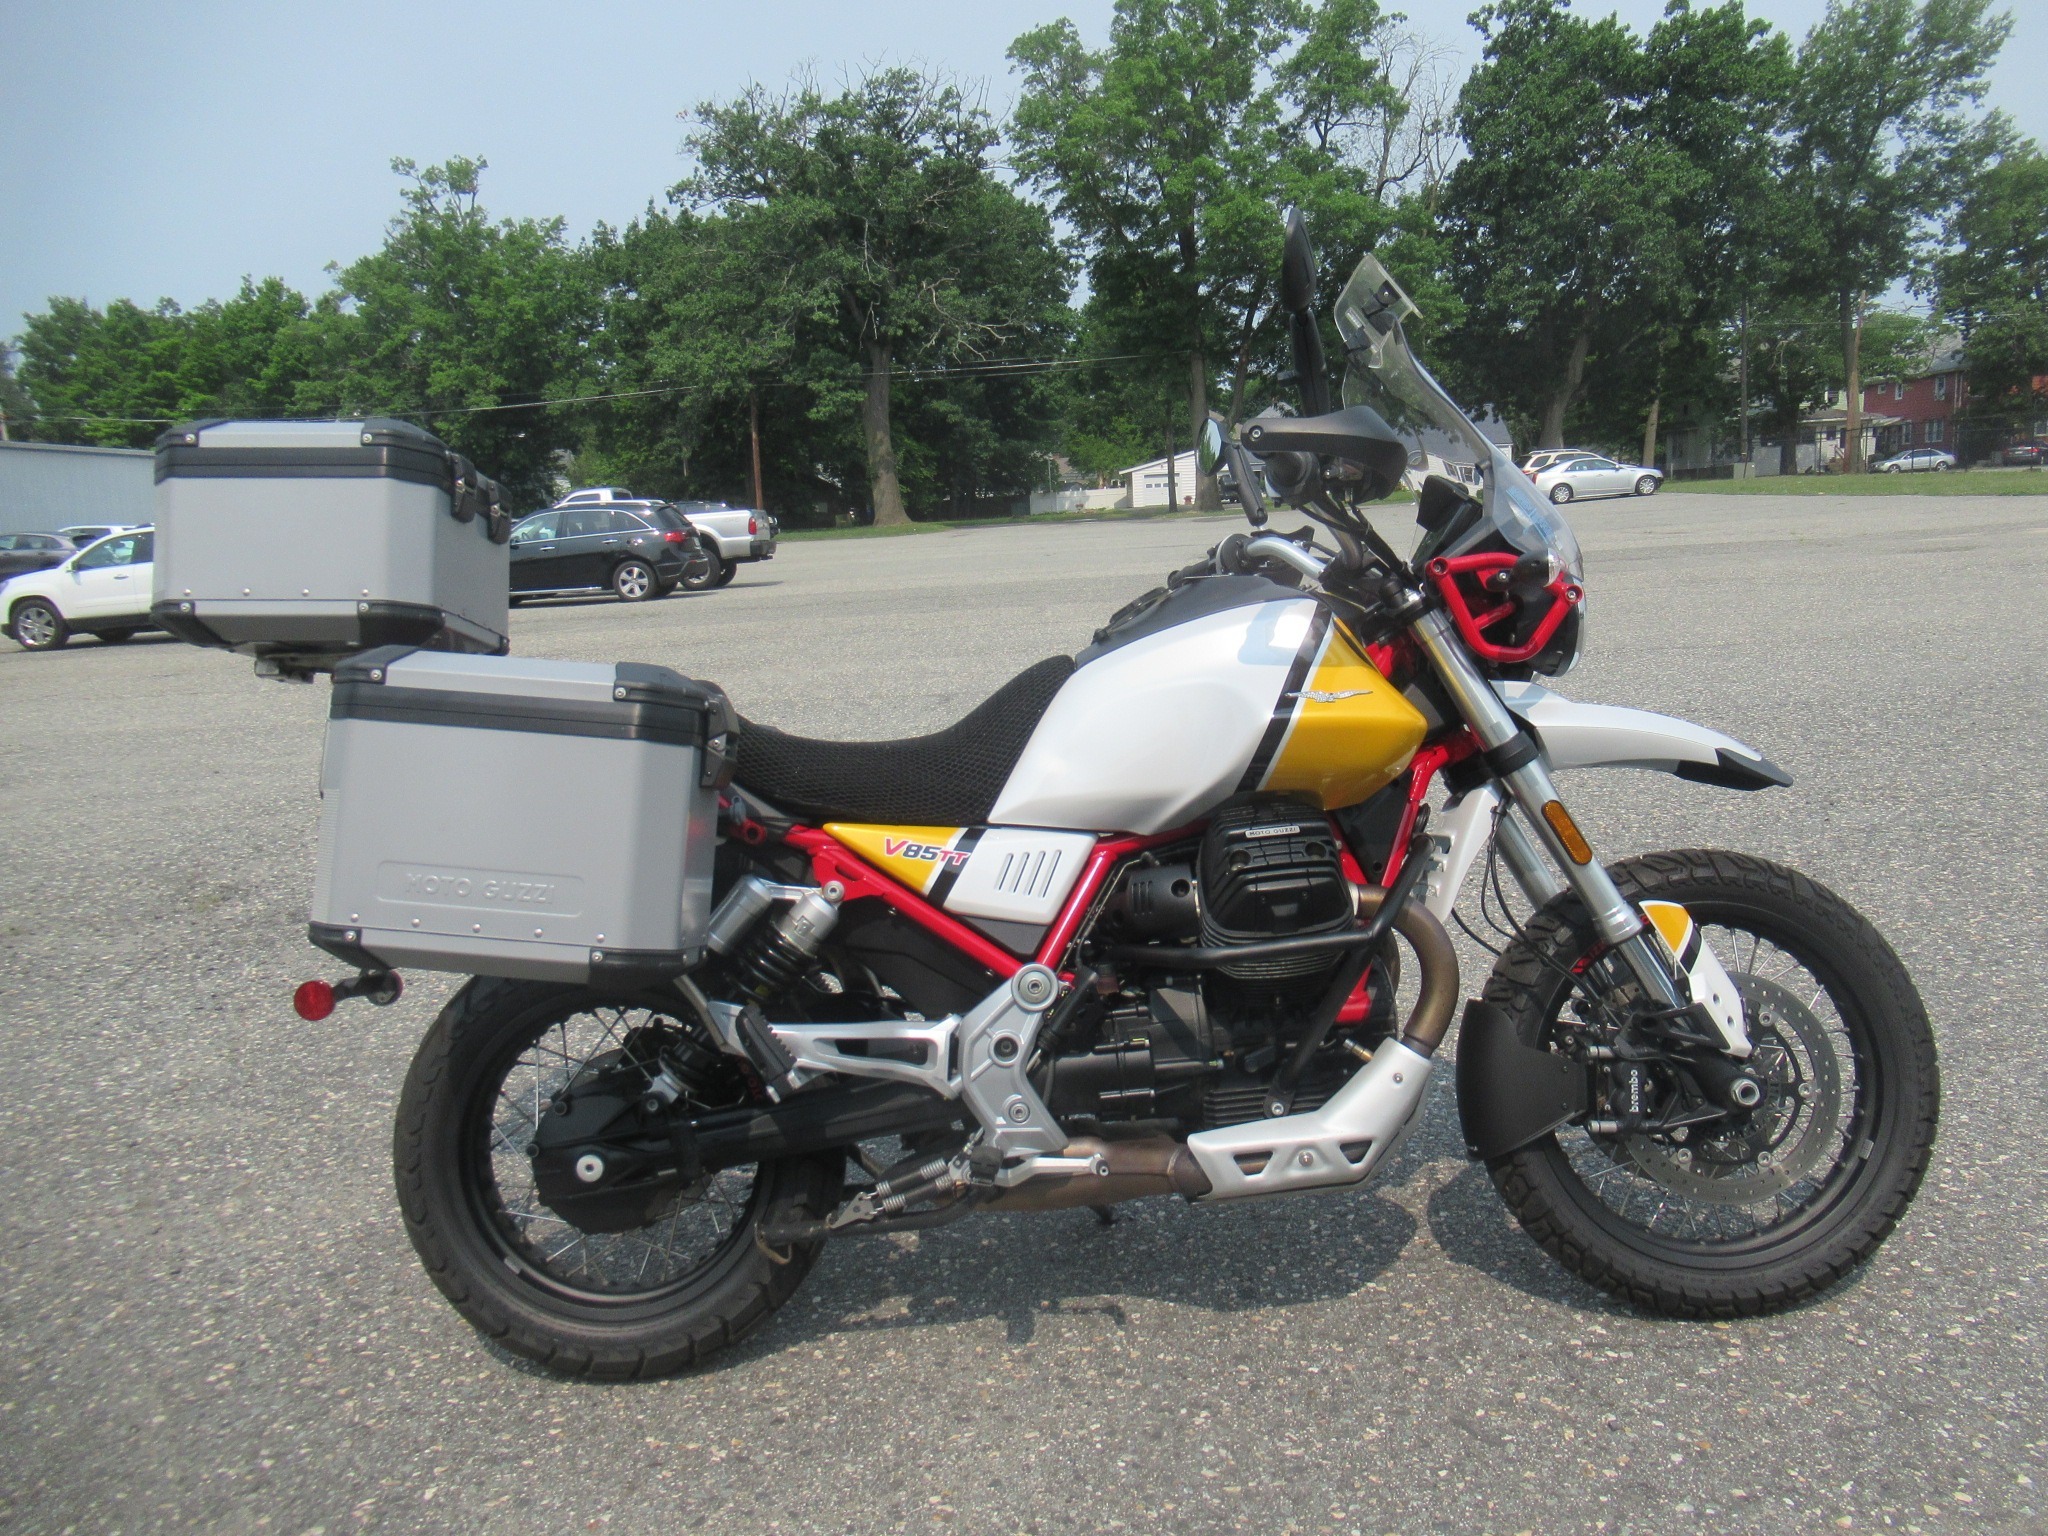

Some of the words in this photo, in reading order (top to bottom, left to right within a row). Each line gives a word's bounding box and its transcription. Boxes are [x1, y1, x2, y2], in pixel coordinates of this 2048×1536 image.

[885, 837, 971, 865] V85TT
[406, 873, 472, 897] MOTO
[482, 880, 555, 904] GUZZI
[1629, 1069, 1639, 1112] brembo
